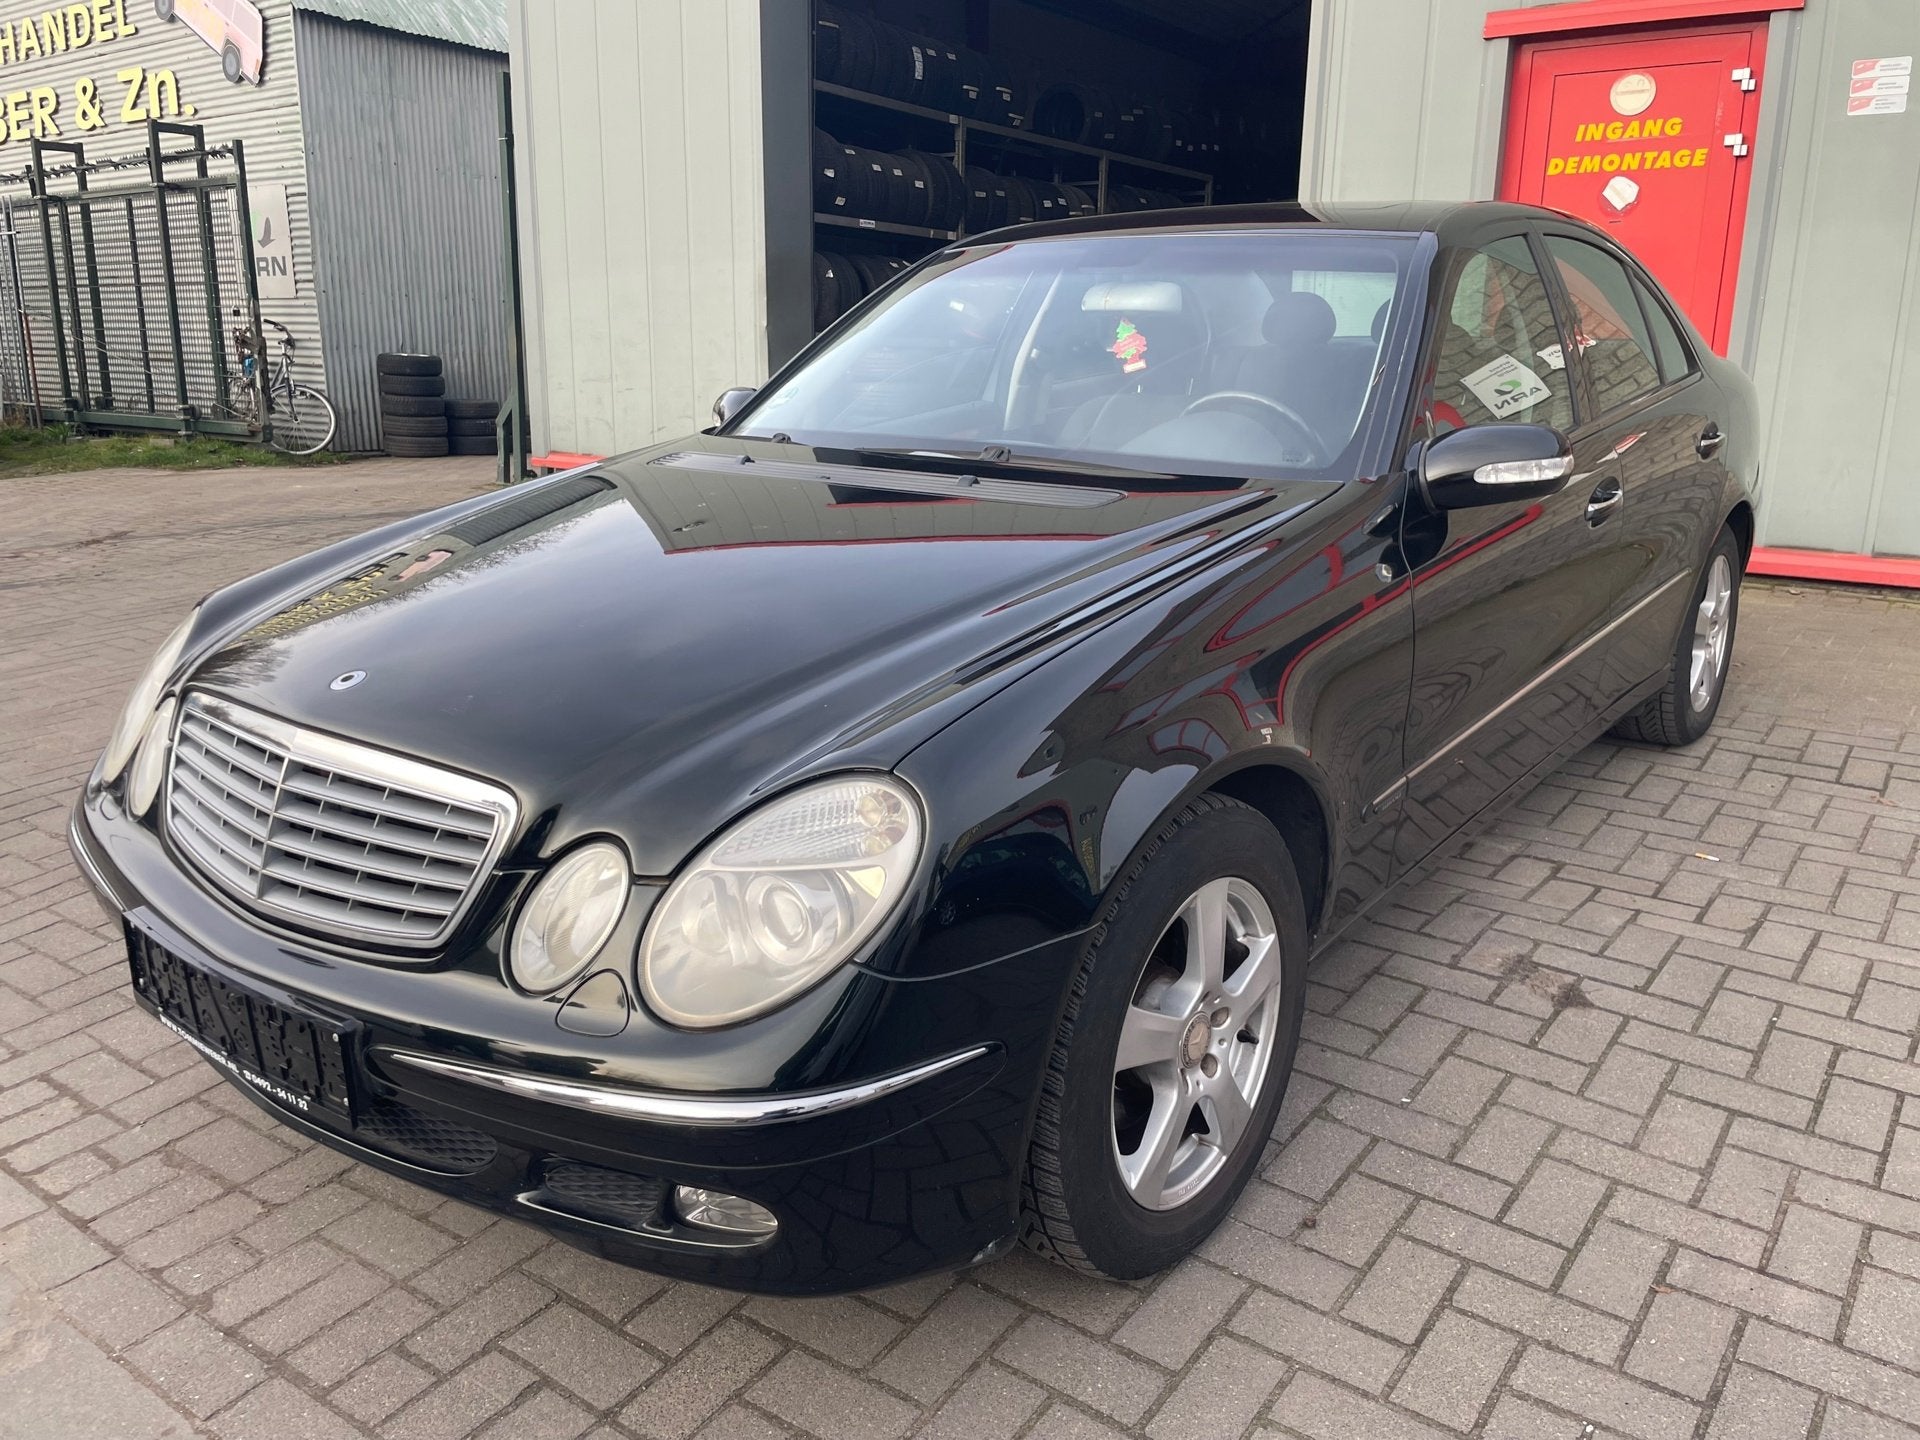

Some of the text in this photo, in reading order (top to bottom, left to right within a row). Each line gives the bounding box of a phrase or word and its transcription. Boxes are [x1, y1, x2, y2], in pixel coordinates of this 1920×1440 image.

[74, 77, 106, 131] &
[117, 66, 197, 123] Zn.
[1575, 117, 1683, 142] INGANG
[1547, 148, 1709, 176] DEMONTAGE
[255, 255, 288, 277] RN
